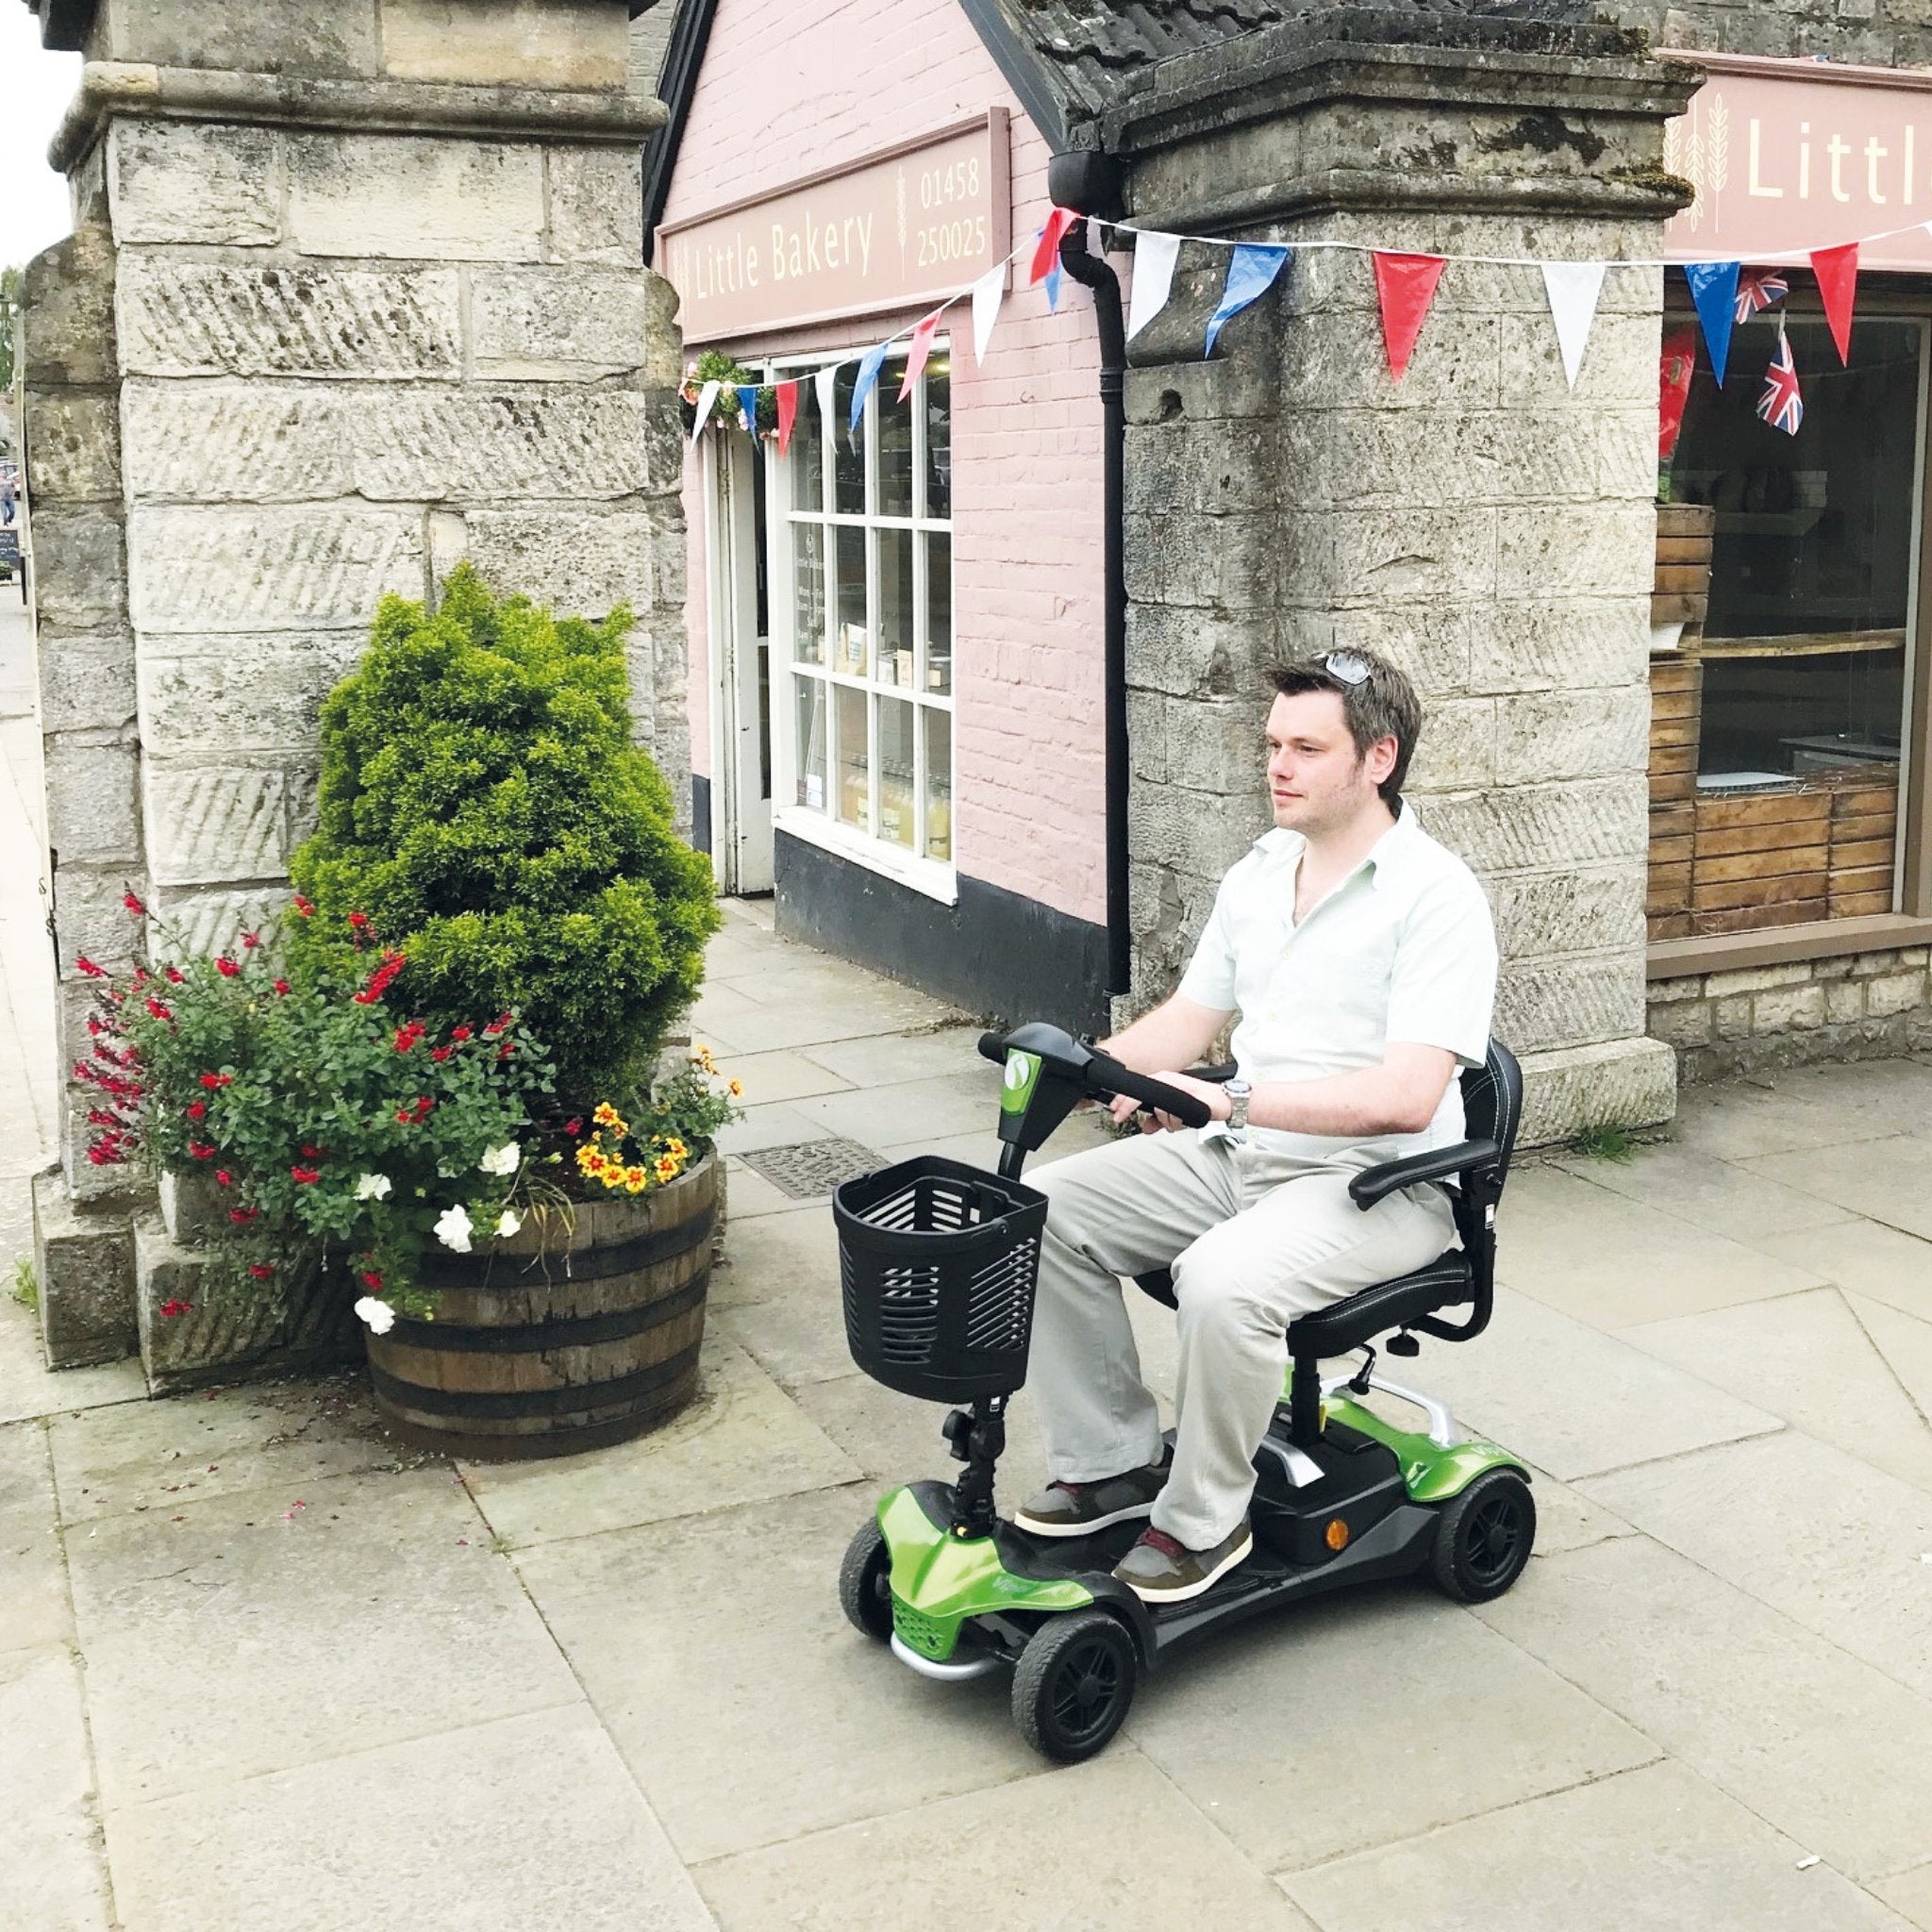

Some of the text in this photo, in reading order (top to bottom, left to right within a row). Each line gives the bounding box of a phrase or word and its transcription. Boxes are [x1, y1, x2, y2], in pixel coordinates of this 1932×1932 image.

[921, 158, 979, 209] 01458
[1748, 118, 1932, 206] Littl
[695, 211, 873, 299] Little Bakery
[917, 216, 985, 266] 250025
